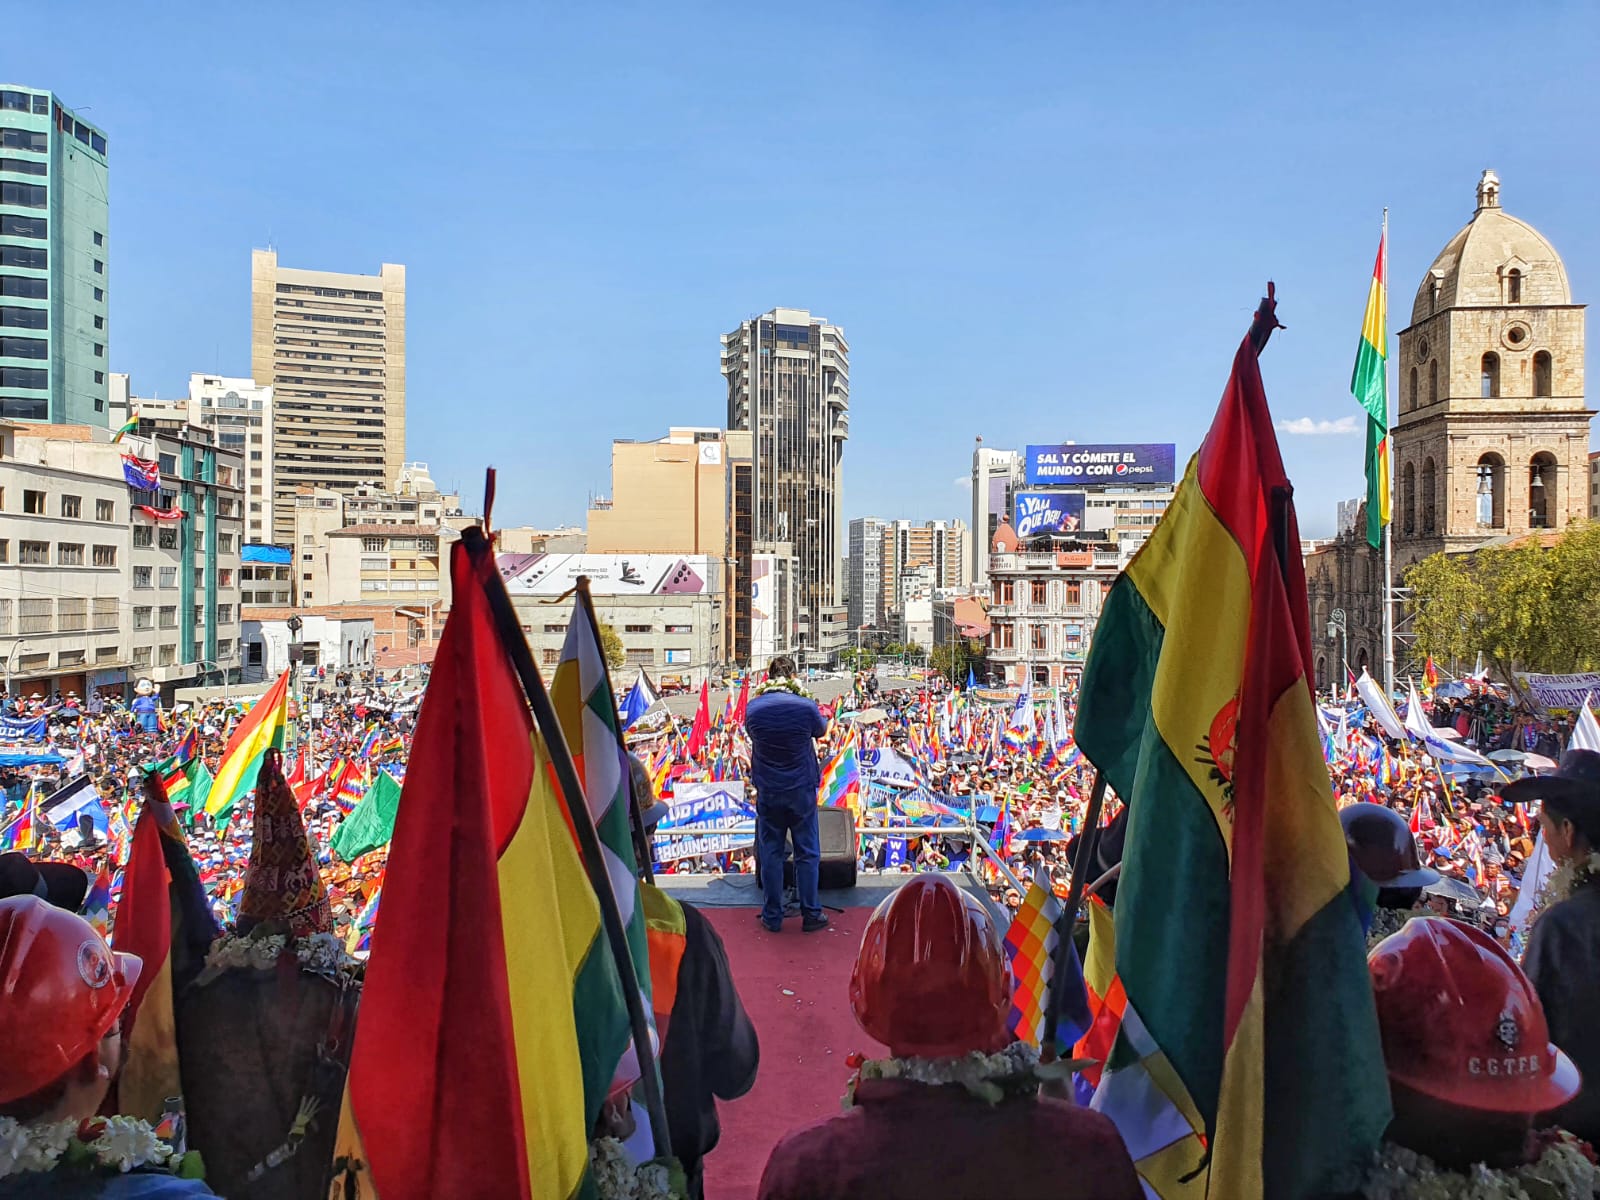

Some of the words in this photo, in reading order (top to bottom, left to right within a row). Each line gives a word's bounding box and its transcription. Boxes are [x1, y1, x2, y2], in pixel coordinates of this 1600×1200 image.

[1037, 453, 1059, 464] SAL
[1061, 453, 1070, 464] Y
[1072, 450, 1120, 464] CÓMETE
[1122, 452, 1136, 463] EL
[1037, 465, 1083, 476] MUNDO
[1086, 464, 1113, 476] CON
